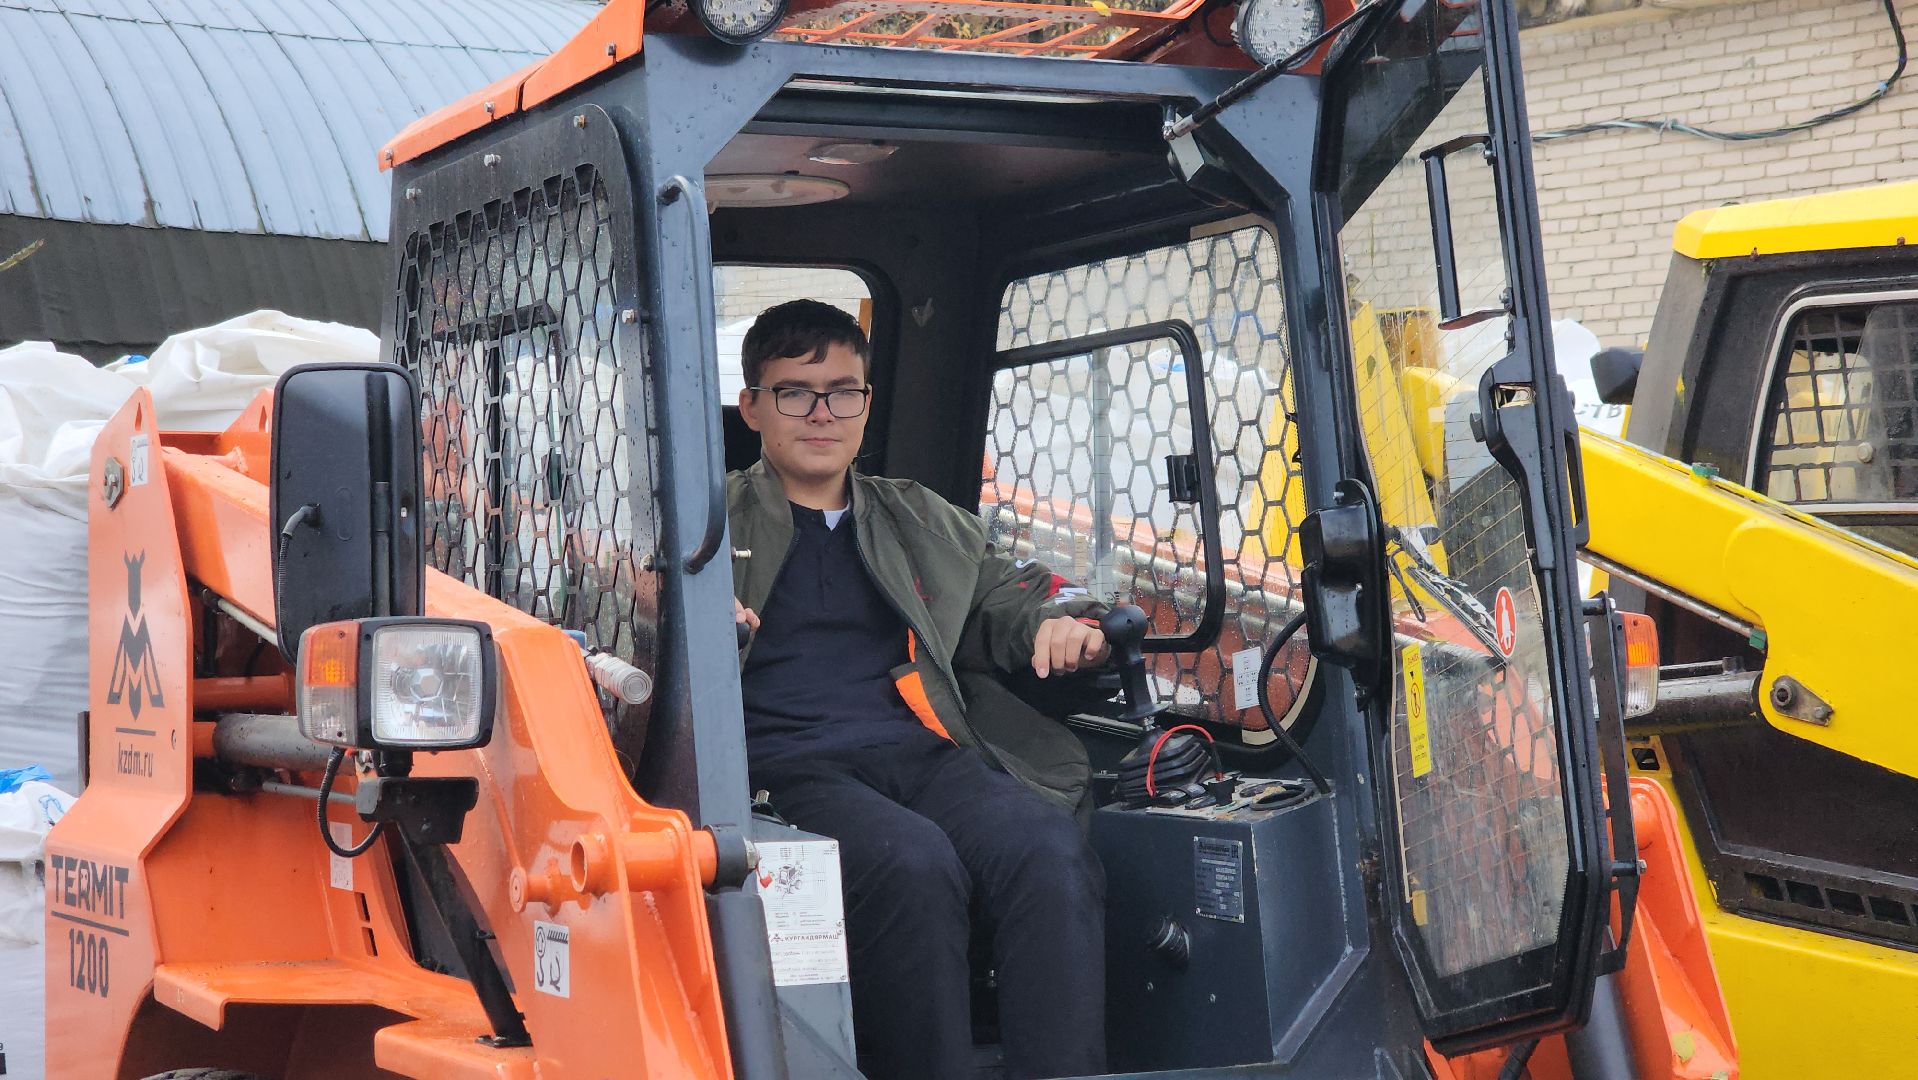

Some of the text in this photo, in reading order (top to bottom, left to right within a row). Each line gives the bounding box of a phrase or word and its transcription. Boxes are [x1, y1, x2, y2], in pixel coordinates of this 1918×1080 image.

[117, 743, 153, 778] kzdm.ru
[51, 854, 129, 919] TERMIT
[69, 928, 109, 998] 1200
